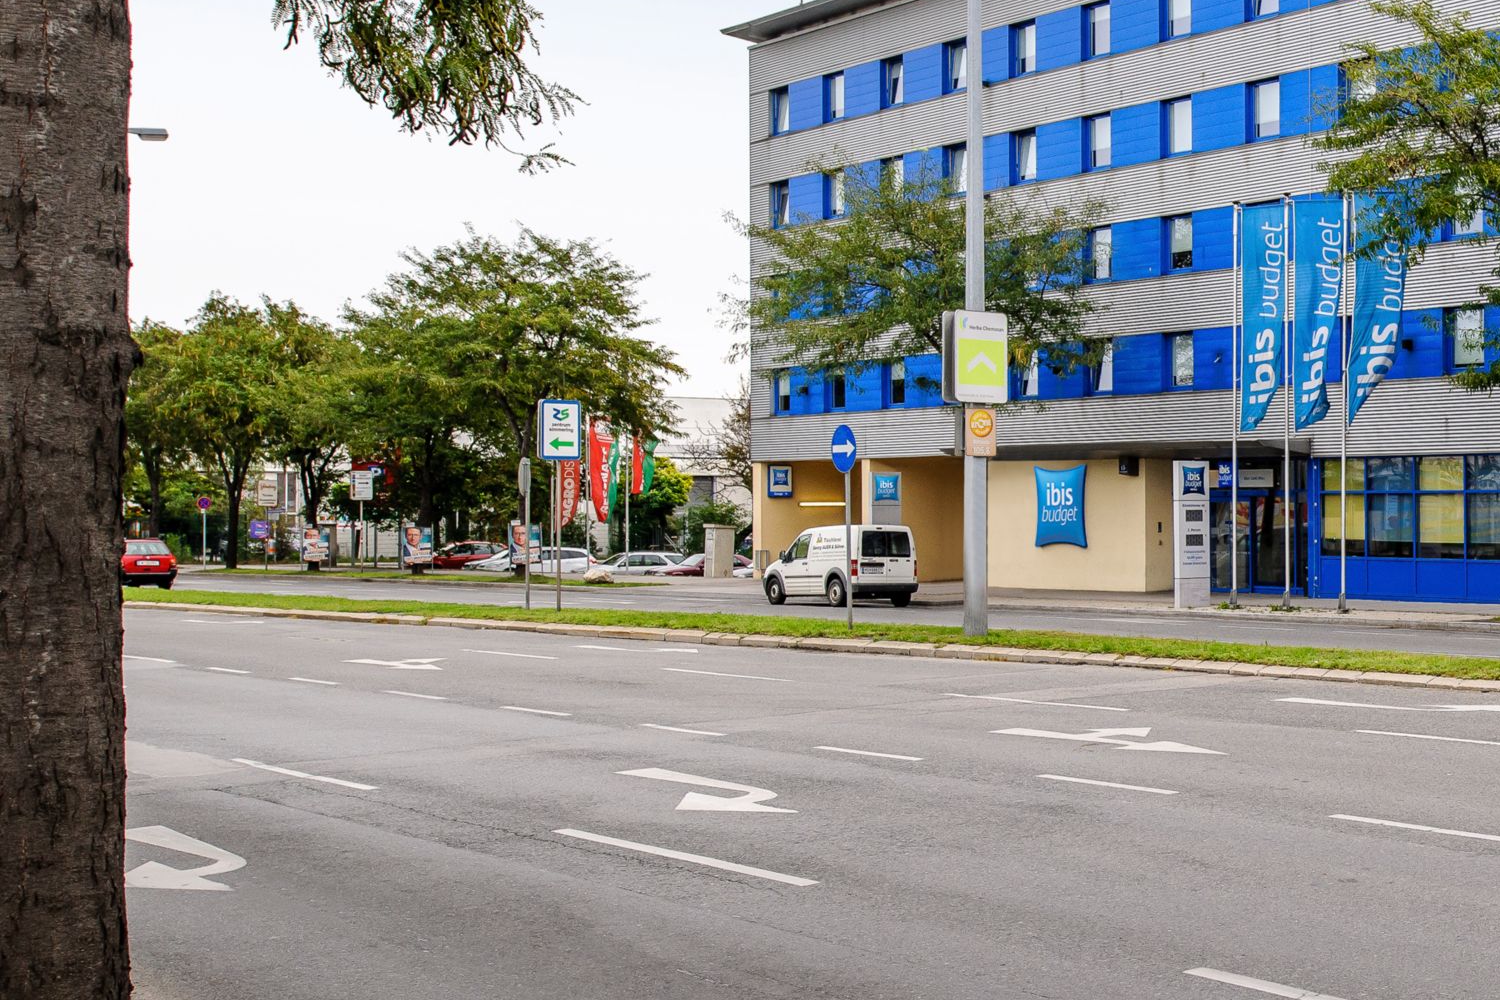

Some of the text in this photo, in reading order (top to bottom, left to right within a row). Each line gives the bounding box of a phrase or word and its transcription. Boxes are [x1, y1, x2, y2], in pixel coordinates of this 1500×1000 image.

[1314, 217, 1342, 316] budget
[1249, 328, 1275, 404] ibis
[1302, 325, 1329, 403] ibis
[1187, 472, 1200, 480] ibis
[1219, 465, 1230, 474] ibis
[879, 480, 894, 488] ibis
[1046, 482, 1073, 506] ibis
[1185, 480, 1202, 488] budget
[1042, 505, 1078, 526] budget
